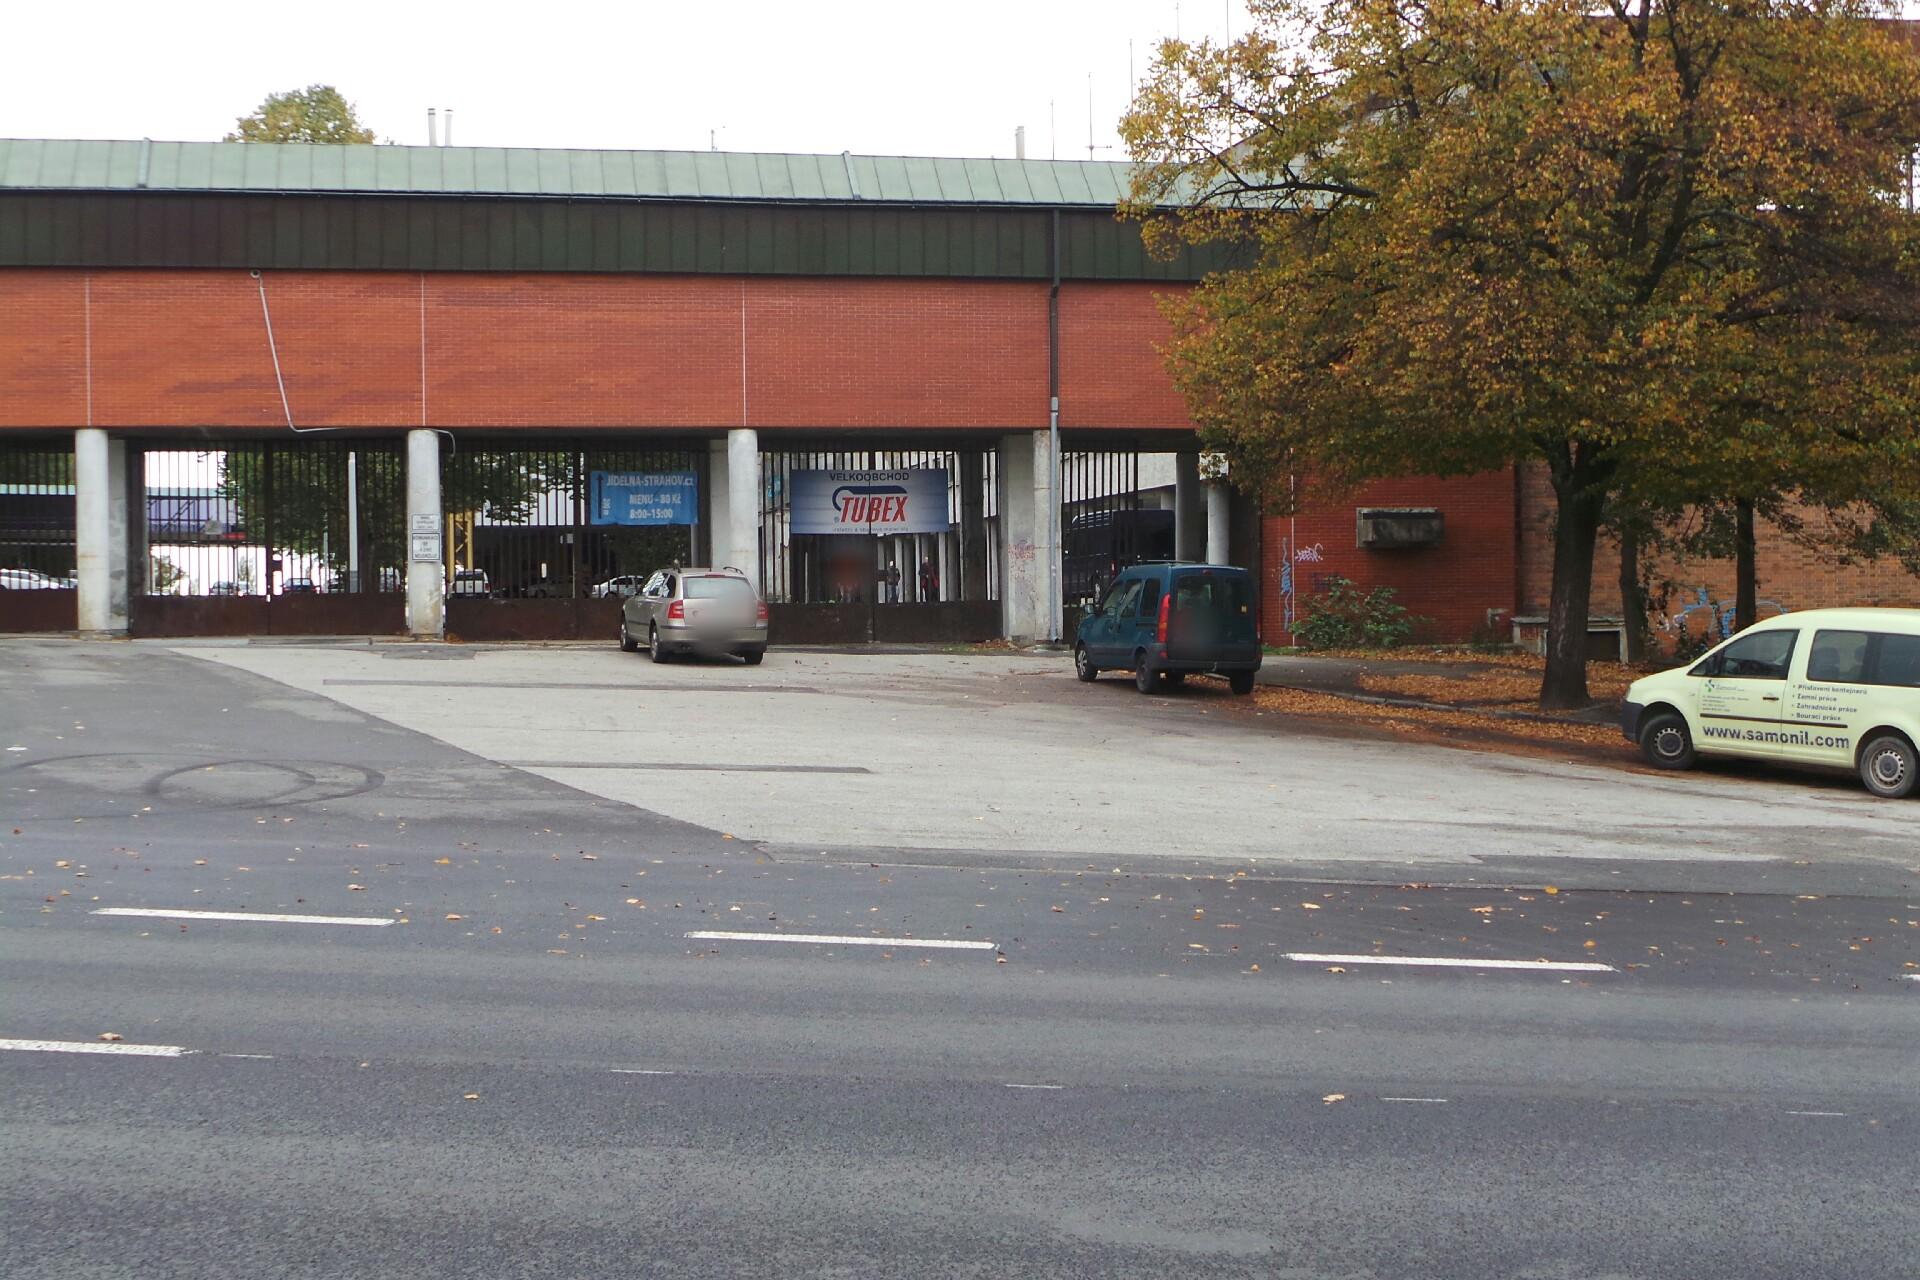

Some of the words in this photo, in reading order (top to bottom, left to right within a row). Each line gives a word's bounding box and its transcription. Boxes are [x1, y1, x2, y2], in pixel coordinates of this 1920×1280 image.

[830, 472, 910, 482] VELKOOBCHOD
[840, 495, 909, 523] TUBEX
[1702, 725, 1849, 748] www.samonil.com
